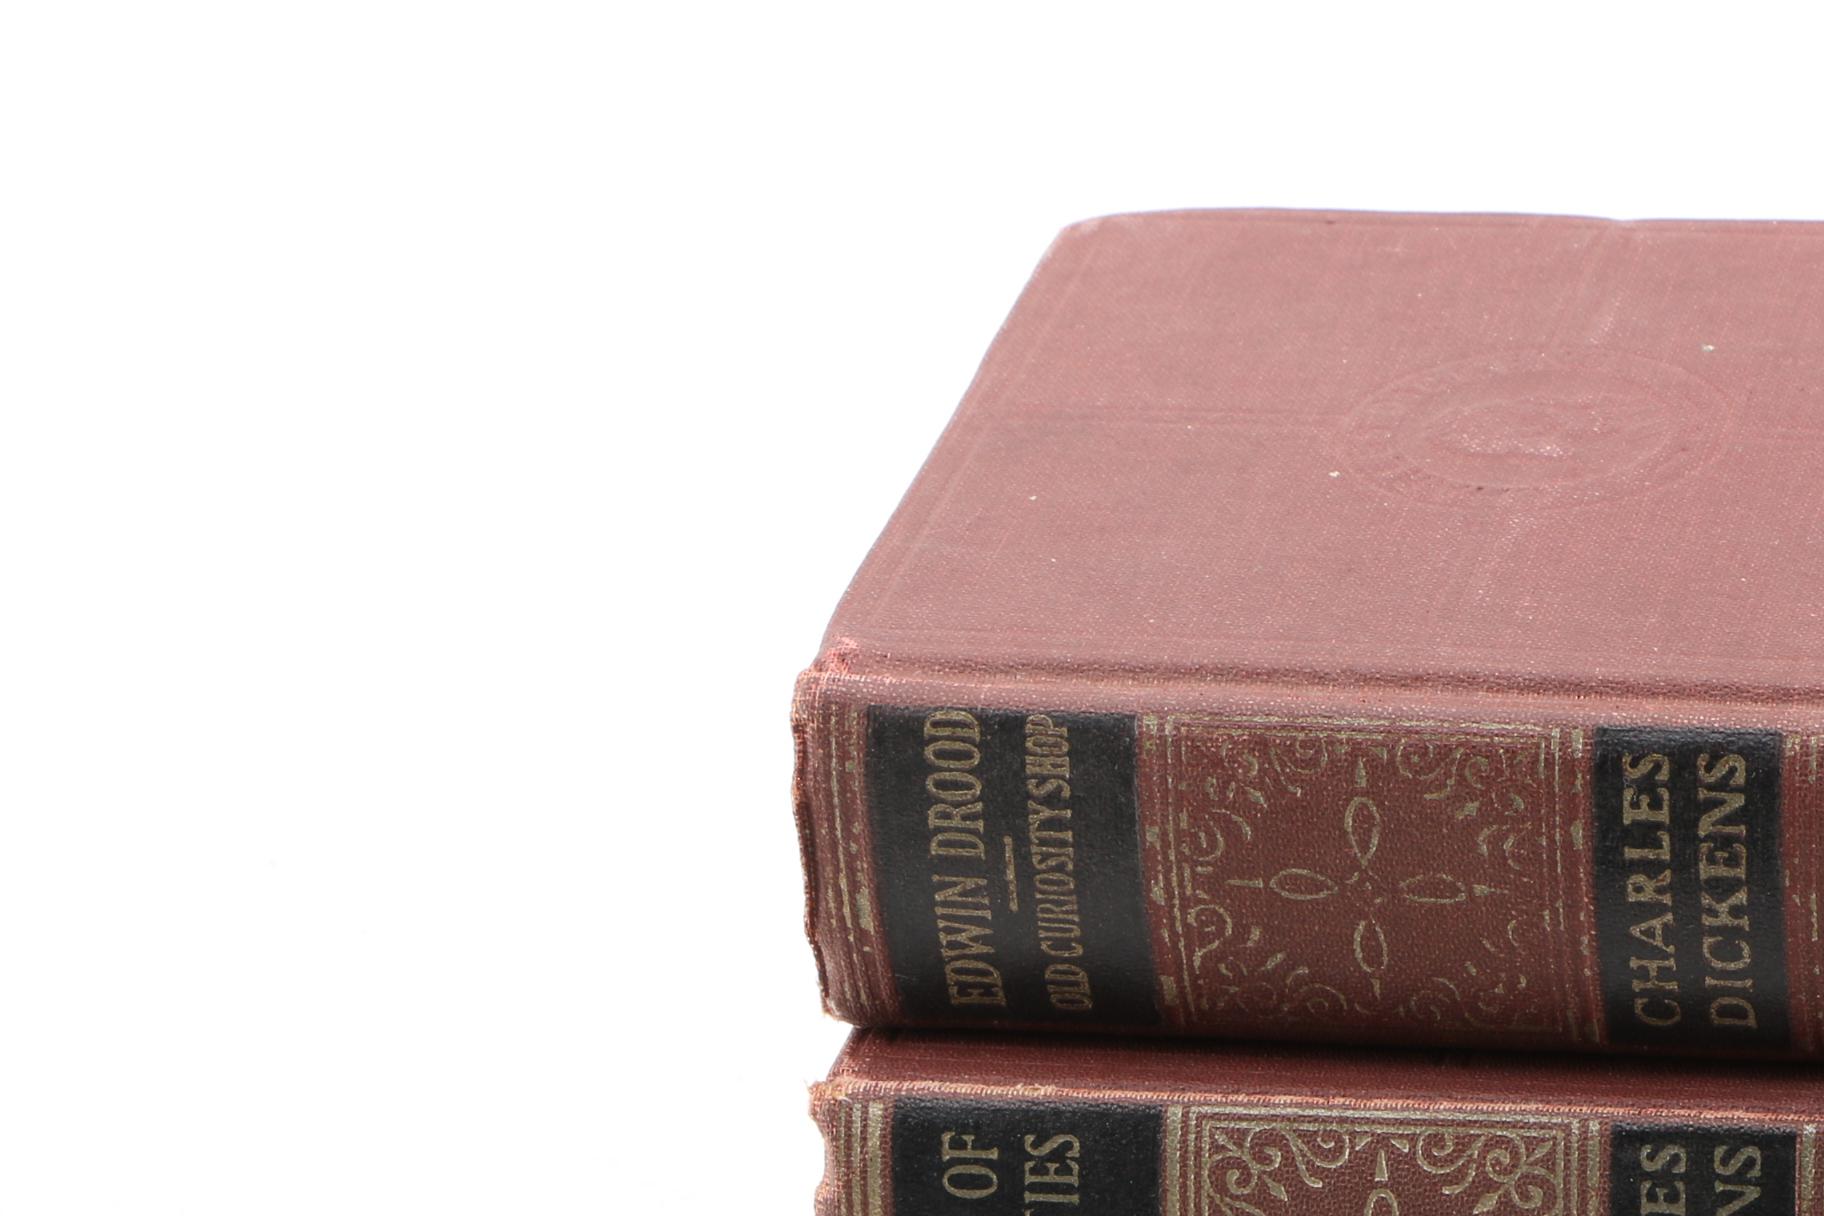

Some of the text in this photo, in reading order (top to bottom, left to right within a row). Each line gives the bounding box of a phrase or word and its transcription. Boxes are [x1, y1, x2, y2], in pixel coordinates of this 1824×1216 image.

[923, 710, 1007, 1007] EDWIN DROOD
[1024, 714, 1093, 1010] OLD CURIOSITY SHOP
[1621, 752, 1682, 1027] CHARLES
[1696, 753, 1758, 1029] DICKENS
[941, 1130, 999, 1199] OF
